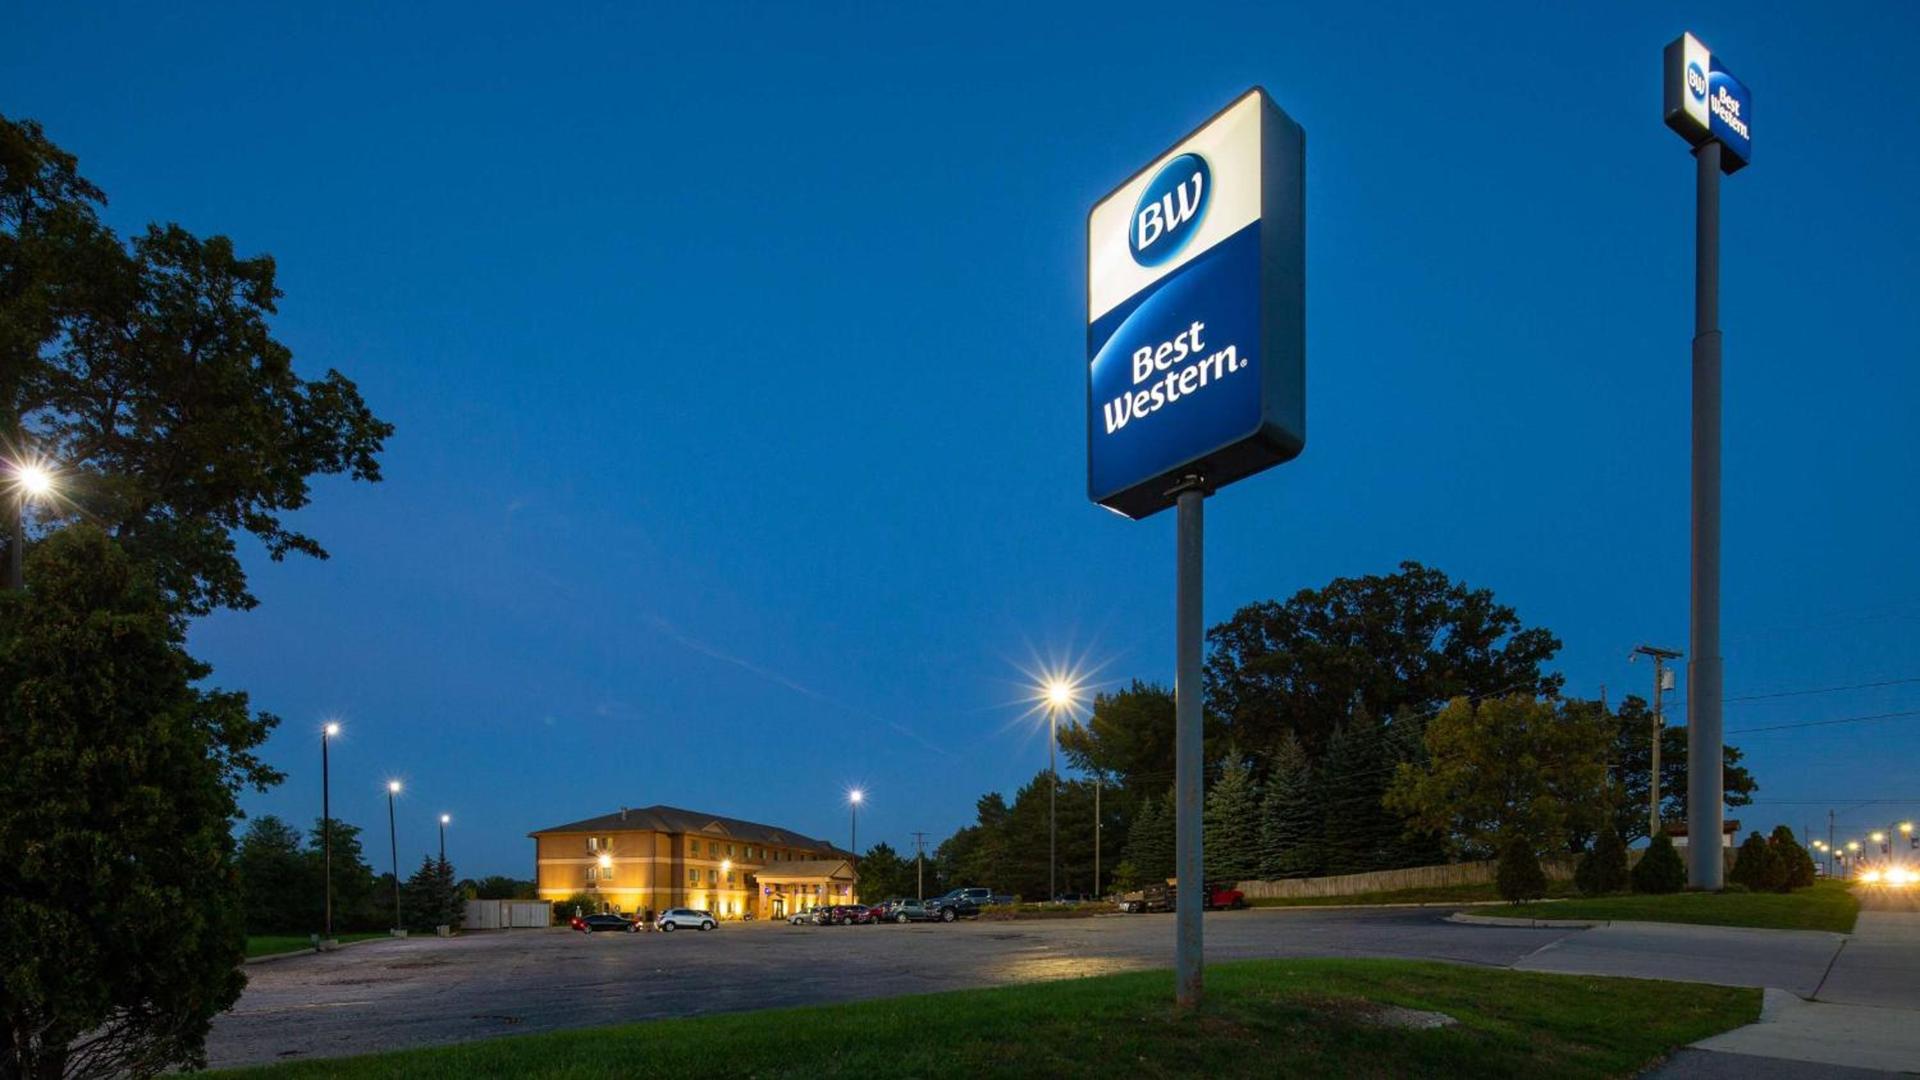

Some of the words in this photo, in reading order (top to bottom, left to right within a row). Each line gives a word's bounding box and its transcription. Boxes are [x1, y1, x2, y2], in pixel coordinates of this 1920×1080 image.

[1690, 68, 1705, 95] BW
[1719, 86, 1740, 116] Best
[1137, 172, 1202, 251] BW
[1132, 321, 1206, 385] Best
